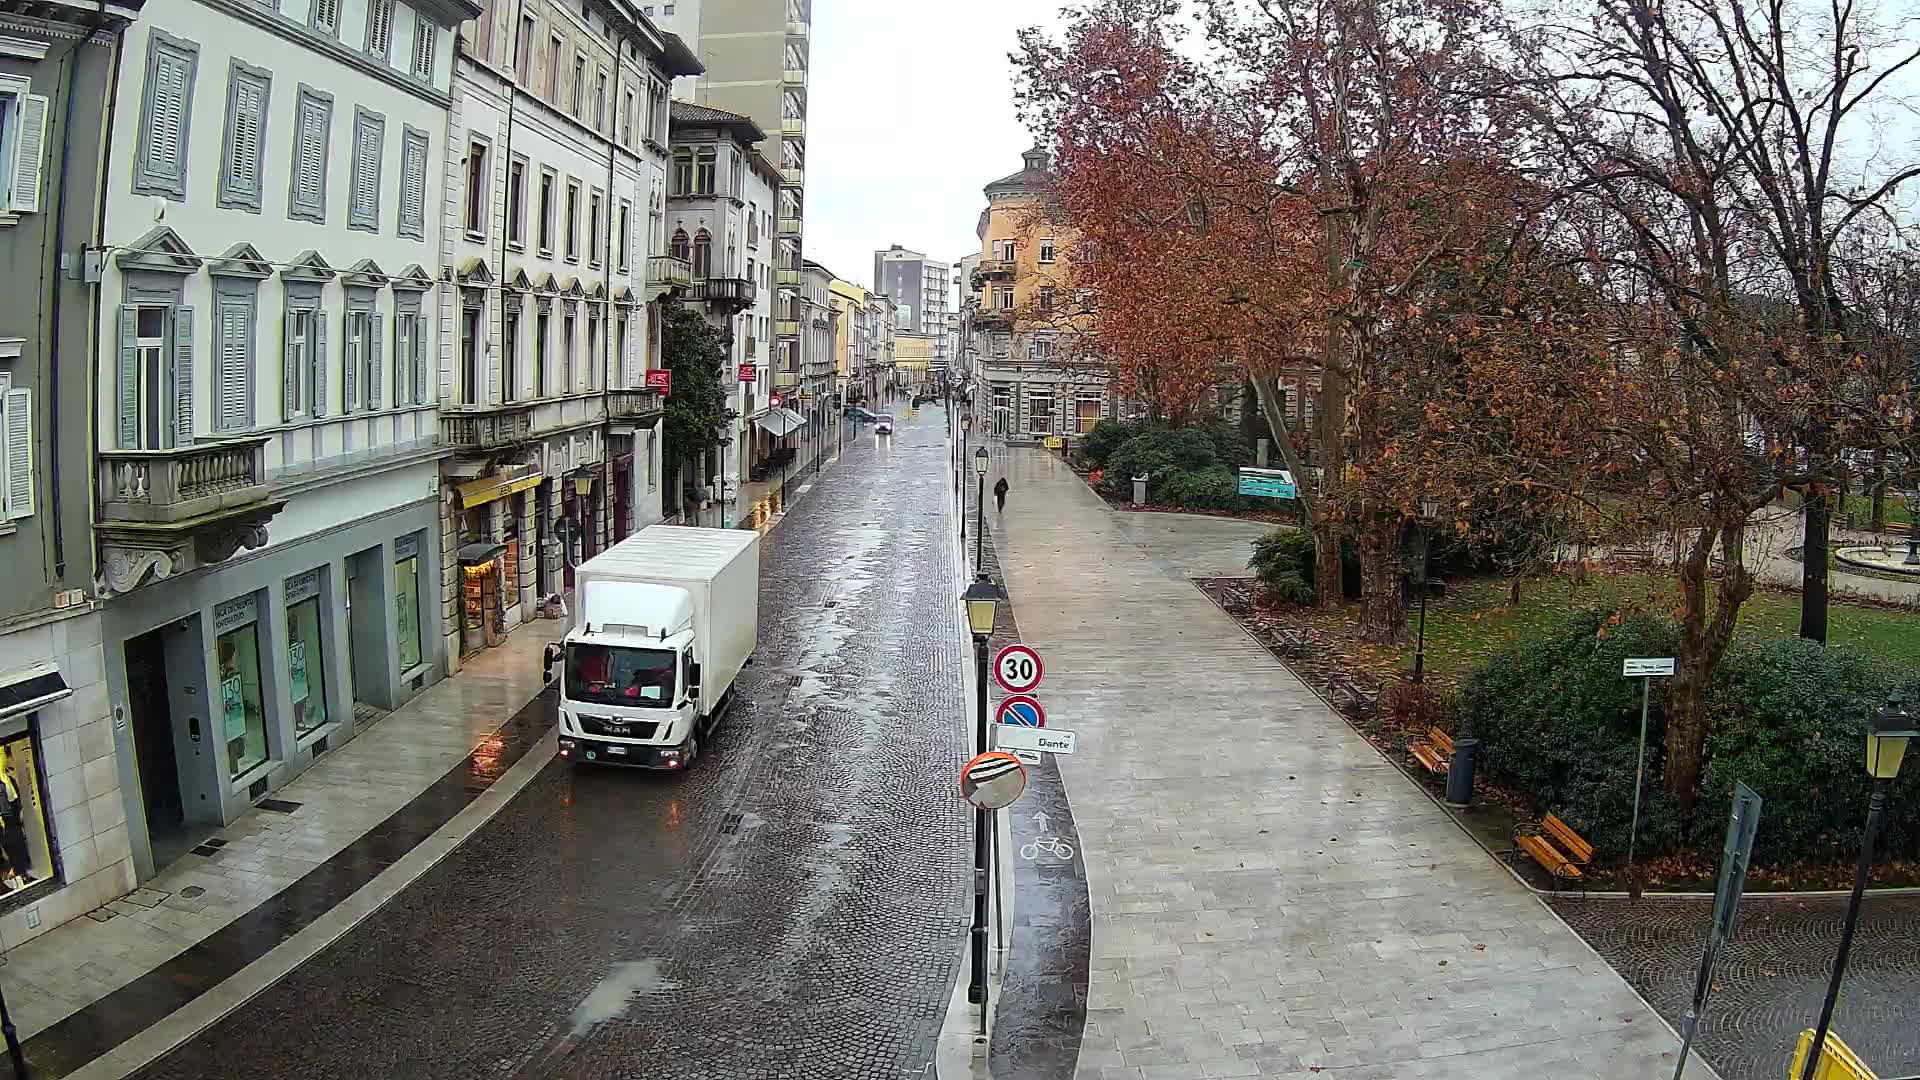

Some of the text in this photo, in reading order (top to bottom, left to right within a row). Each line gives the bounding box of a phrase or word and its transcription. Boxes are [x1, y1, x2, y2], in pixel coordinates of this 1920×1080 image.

[1005, 658, 1033, 680] 30
[603, 726, 631, 735] MAN
[1038, 738, 1069, 749] Dante
